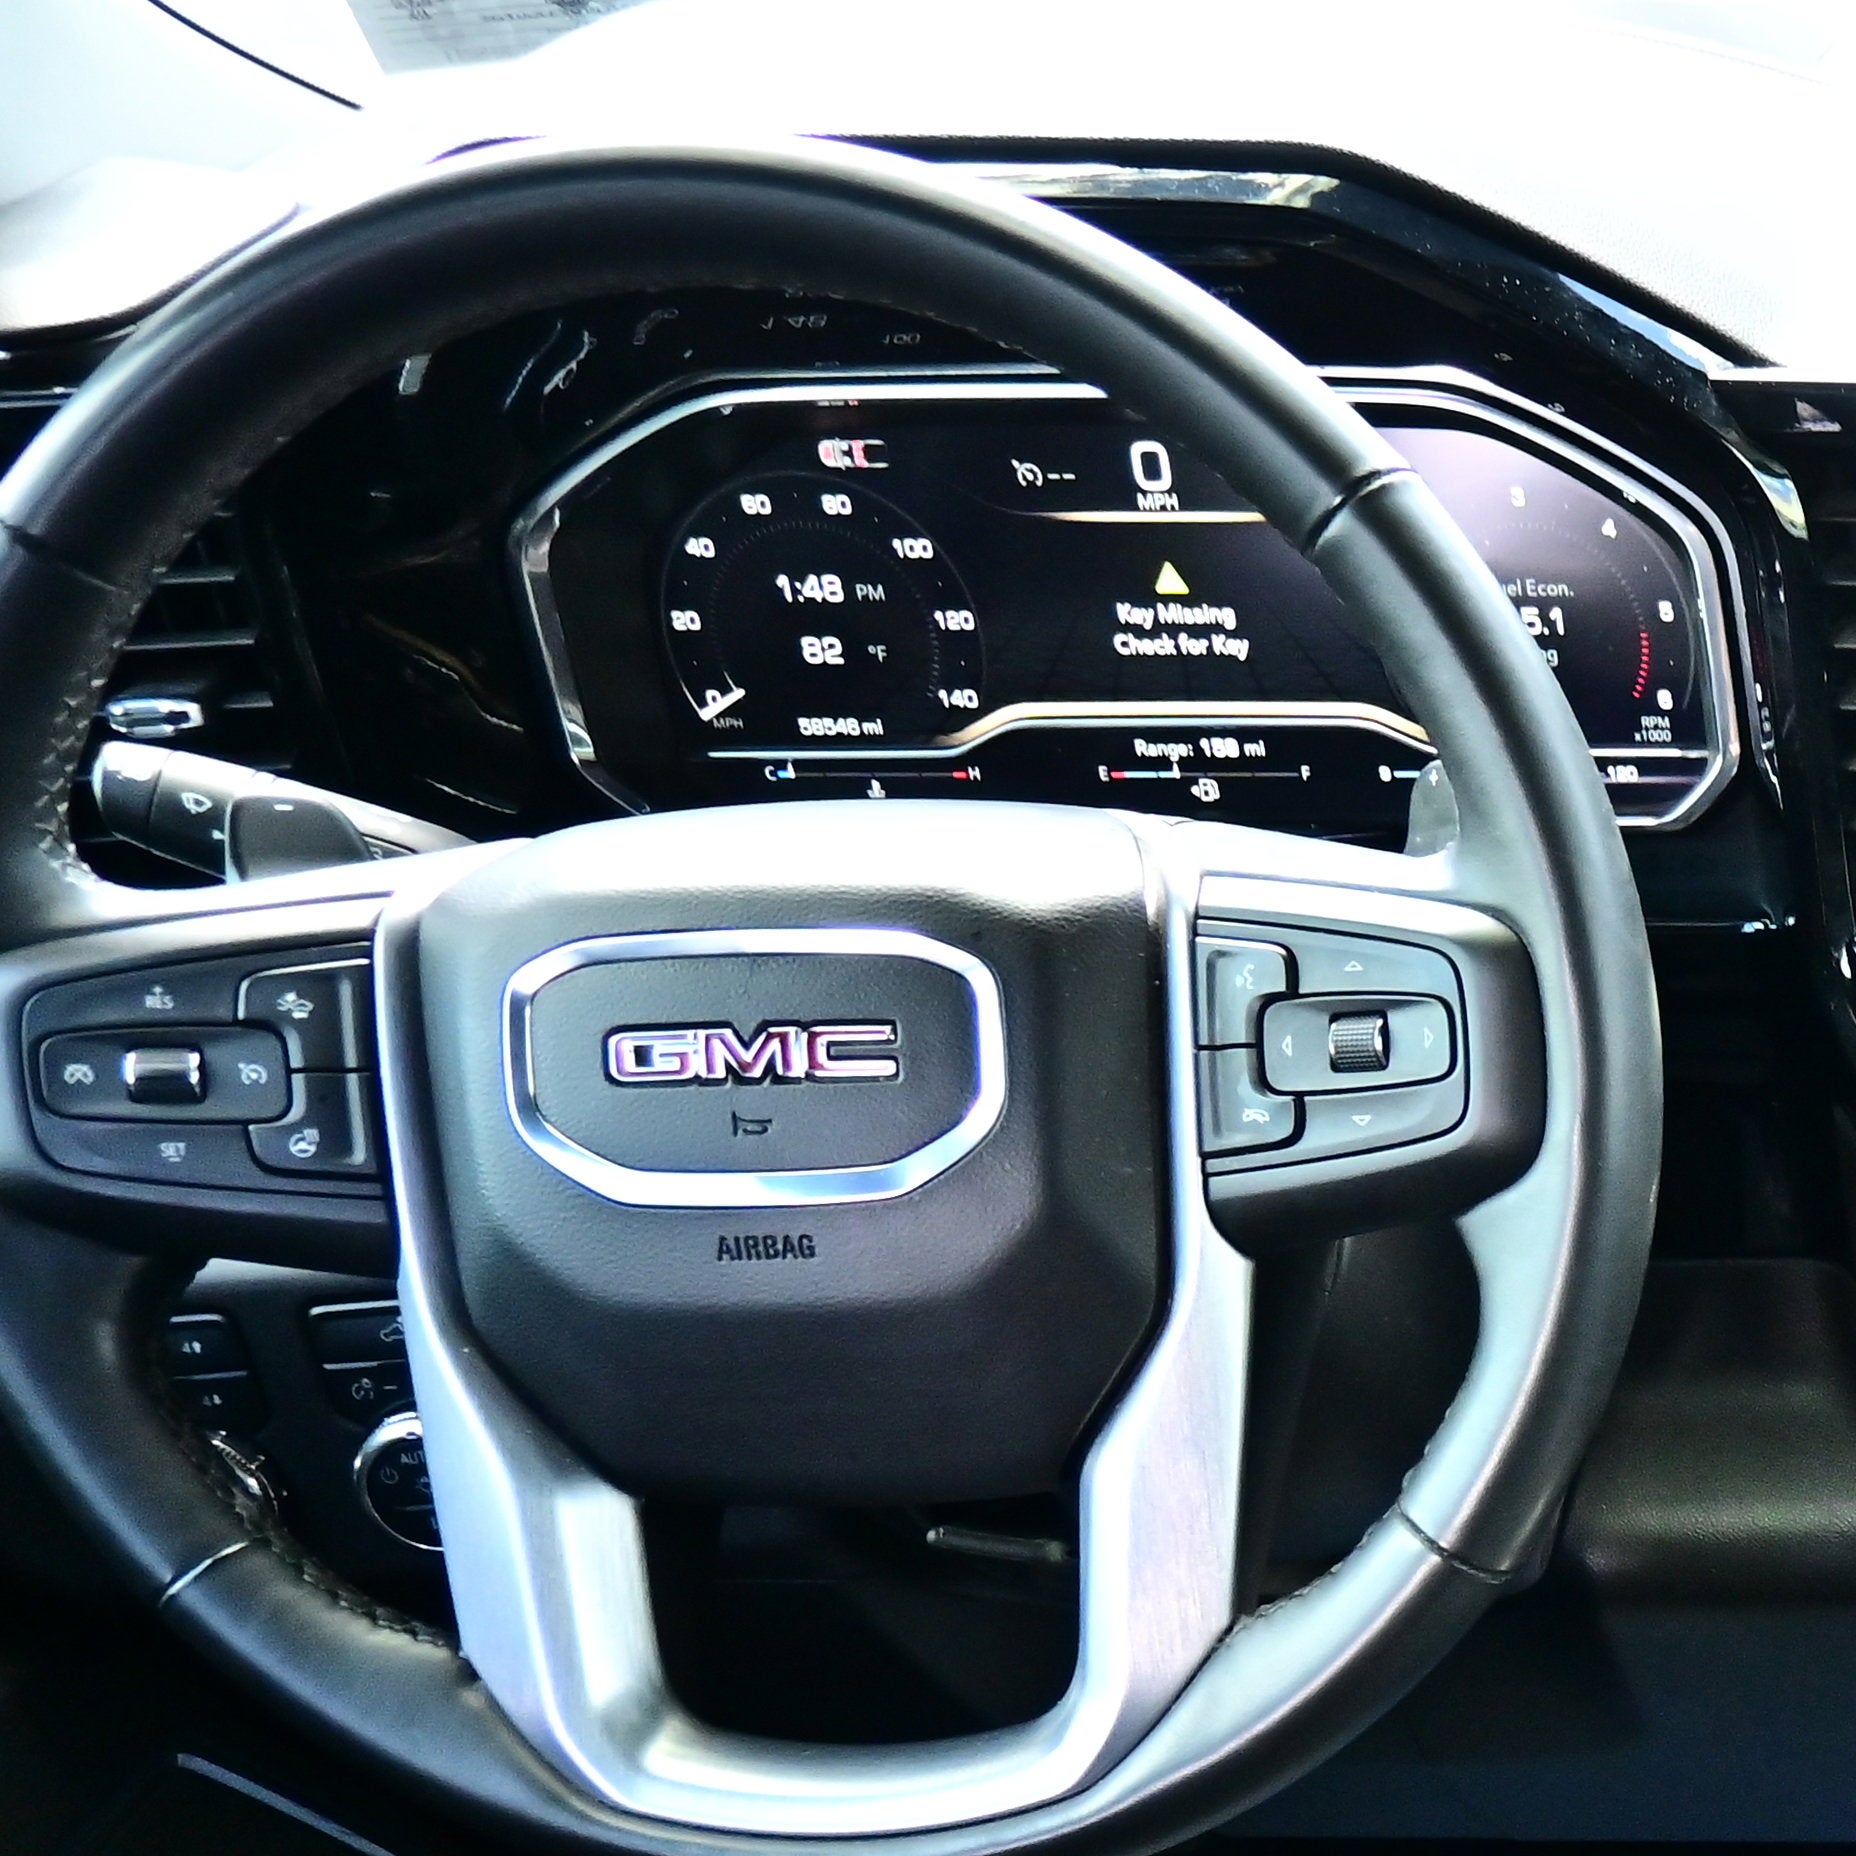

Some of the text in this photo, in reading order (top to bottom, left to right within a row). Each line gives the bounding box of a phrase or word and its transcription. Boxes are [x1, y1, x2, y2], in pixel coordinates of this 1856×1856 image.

[1130, 440, 1173, 492] 0
[740, 494, 772, 515] 60
[821, 494, 852, 515] 80
[1137, 493, 1180, 511] MPH
[1601, 518, 1617, 539] 4
[684, 537, 715, 558] 40
[892, 537, 934, 559] 100
[775, 573, 886, 603] 1:48 PM
[1526, 578, 1575, 597] Econ.
[670, 610, 701, 631] 20
[933, 610, 975, 631] 120
[1116, 602, 1236, 630] Key Missing
[1520, 606, 1566, 637] 5.1
[800, 635, 845, 665] 82
[1113, 632, 1249, 661] Check for Key
[938, 689, 979, 709] 140
[712, 717, 744, 730] MPH
[1641, 715, 1671, 730] RPM
[1633, 729, 1672, 743] x1000
[1133, 738, 1194, 762] Range:
[1244, 739, 1266, 758] mi
[764, 765, 777, 781] C
[968, 766, 981, 781] H
[1098, 765, 1110, 783] E
[1300, 765, 1311, 782] F
[606, 1024, 902, 1085] GMC
[716, 1232, 817, 1262] AIRBAG
[400, 1450, 426, 1465] AUT
